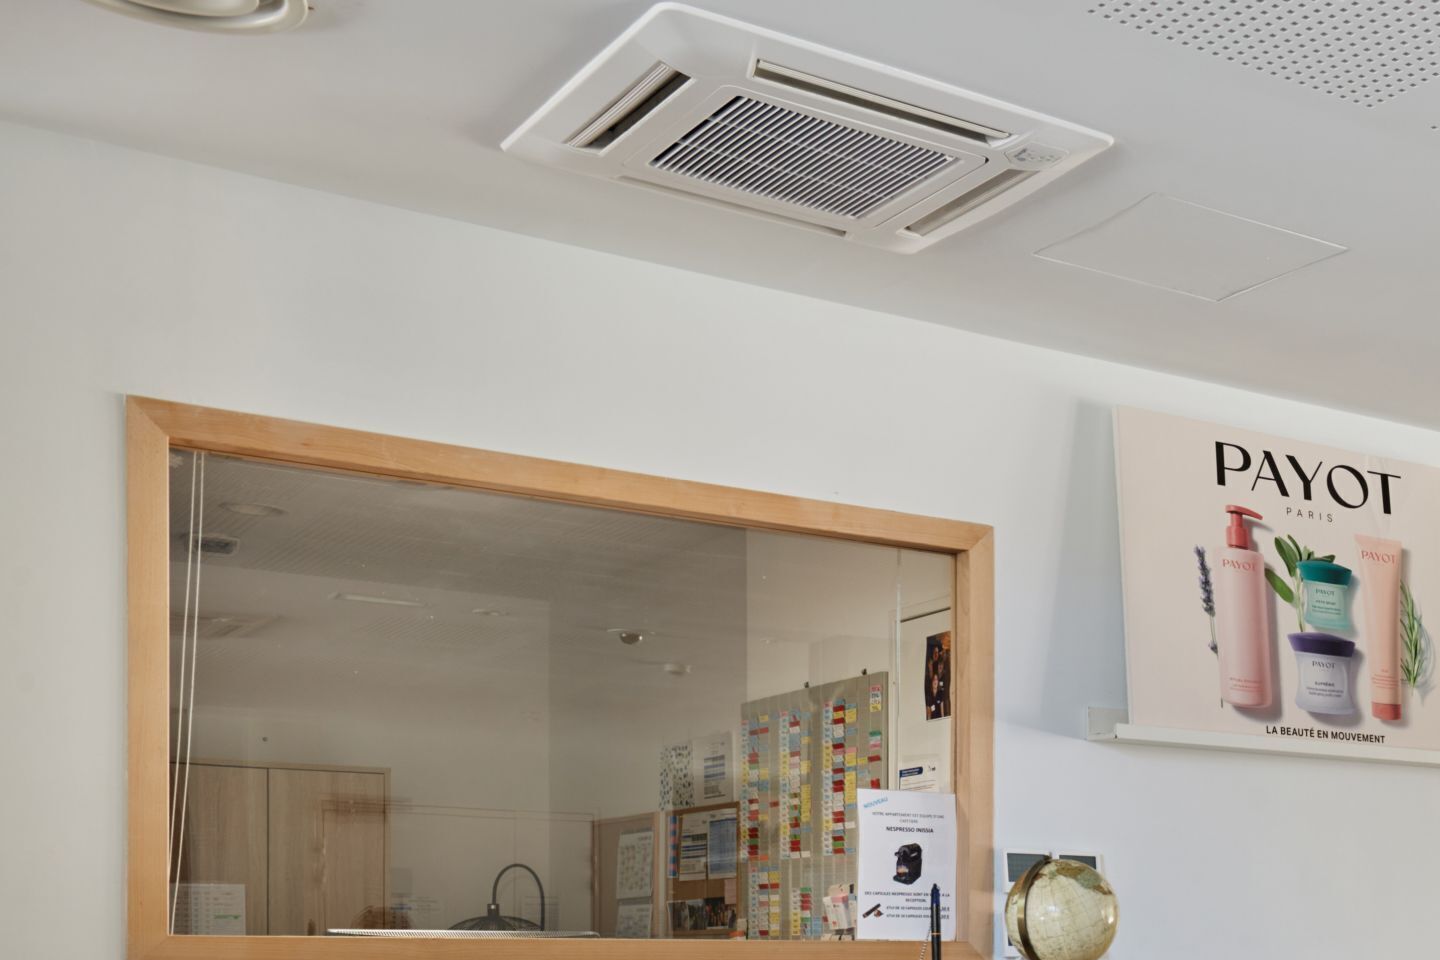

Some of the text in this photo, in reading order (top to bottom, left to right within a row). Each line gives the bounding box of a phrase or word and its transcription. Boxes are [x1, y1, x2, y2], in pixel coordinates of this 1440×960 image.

[1215, 441, 1401, 515] PAYOT
[1286, 507, 1333, 523] PARIS
[1361, 550, 1396, 565] PAYOT
[1222, 558, 1257, 573] PAYOT
[1312, 660, 1336, 670] PAYOT
[1266, 725, 1386, 744] LA BEAUTÉ EN MOUVEMENT
